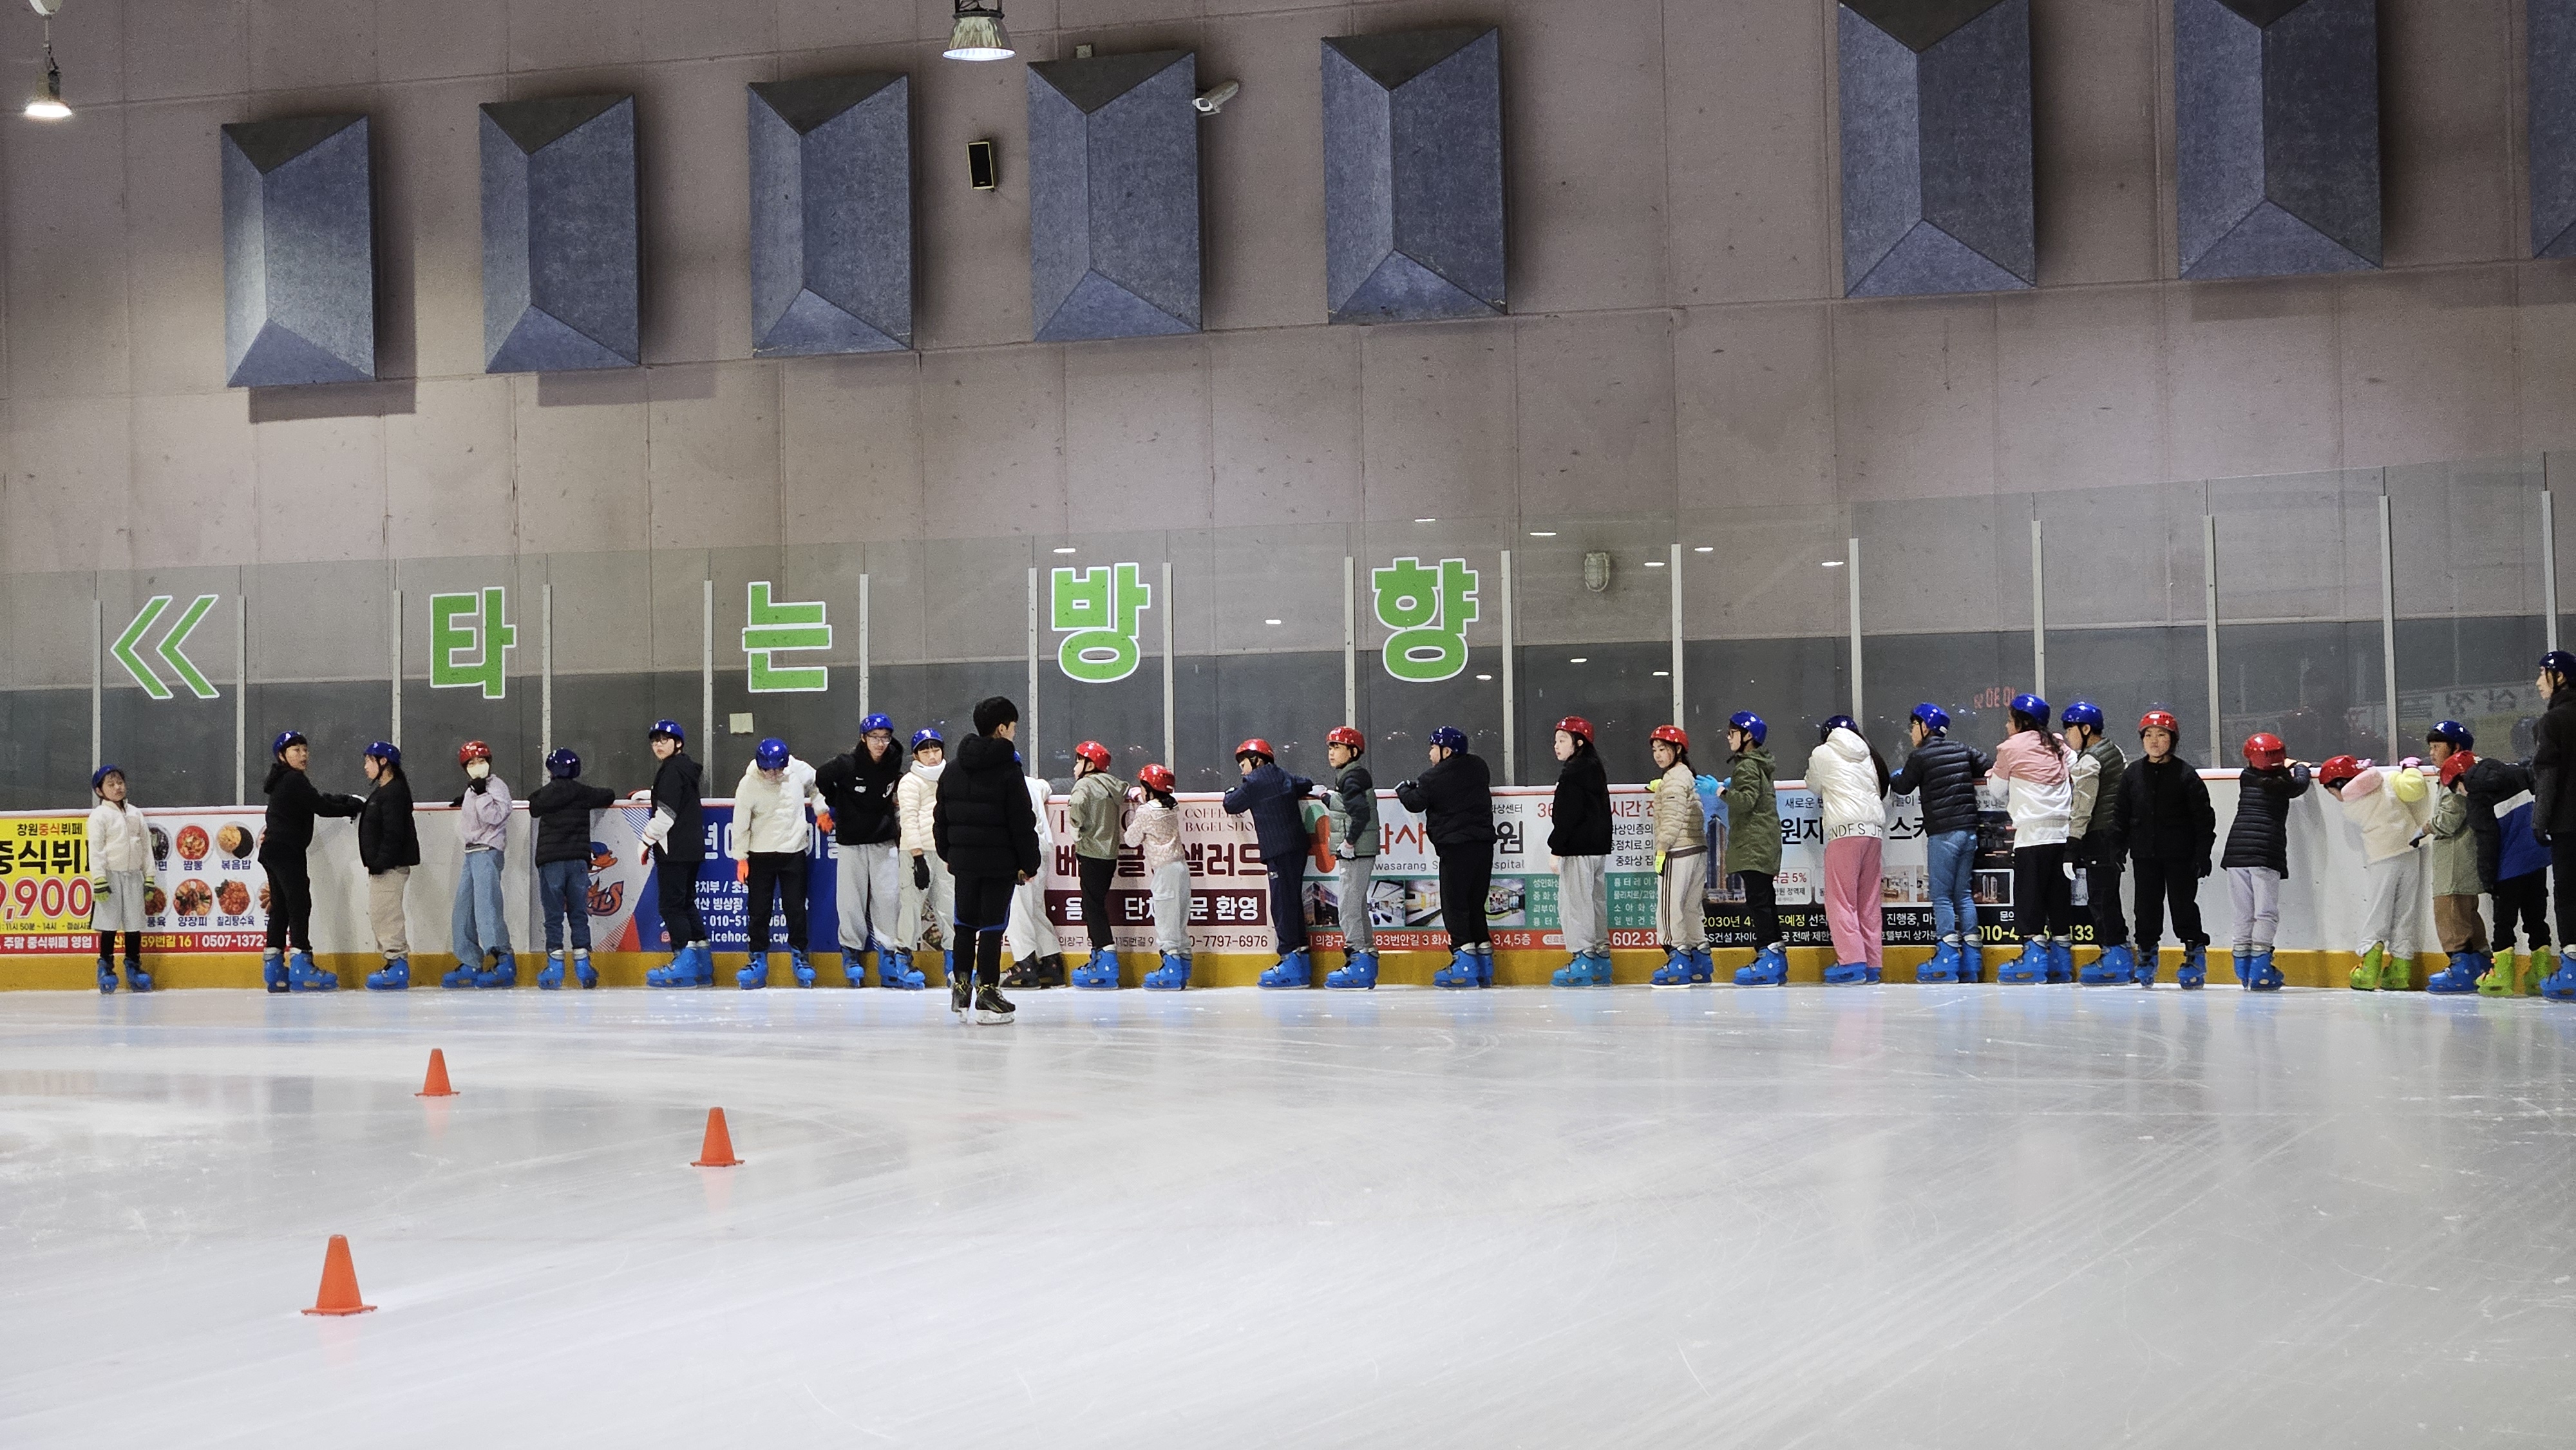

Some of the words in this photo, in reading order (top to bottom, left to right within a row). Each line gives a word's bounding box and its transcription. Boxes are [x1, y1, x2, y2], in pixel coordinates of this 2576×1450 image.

[430, 587, 516, 699] 타
[742, 581, 832, 693] 는
[1051, 562, 1151, 684] 방
[1372, 556, 1481, 684] 향
[1785, 797, 1814, 809] 새로운
[17, 823, 82, 836] 창원중식뷔페
[1186, 822, 1221, 832] BAGEL
[1227, 822, 1254, 831] SHO
[184, 860, 203, 871] 짬뽕
[222, 860, 251, 870] 볶음밥
[1375, 863, 1426, 872] wasarang
[1494, 860, 1525, 871] spital
[1616, 855, 1642, 867] 중화상
[1792, 872, 1807, 883] 5%
[713, 898, 744, 911] 빙상장
[1216, 896, 1258, 921] 환영
[178, 916, 207, 927] 양장피
[1703, 916, 1740, 928] 2030년
[4, 936, 24, 949] 주말
[28, 936, 68, 949] 중식뷔페
[71, 936, 92, 948] 영업
[180, 935, 192, 946] 16
[1058, 936, 1084, 947] 의창구
[1316, 935, 1344, 947] 의창구
[1423, 935, 1429, 946] 3
[1494, 934, 1531, 946] 3,4,5층
[1792, 932, 1810, 942] 전매
